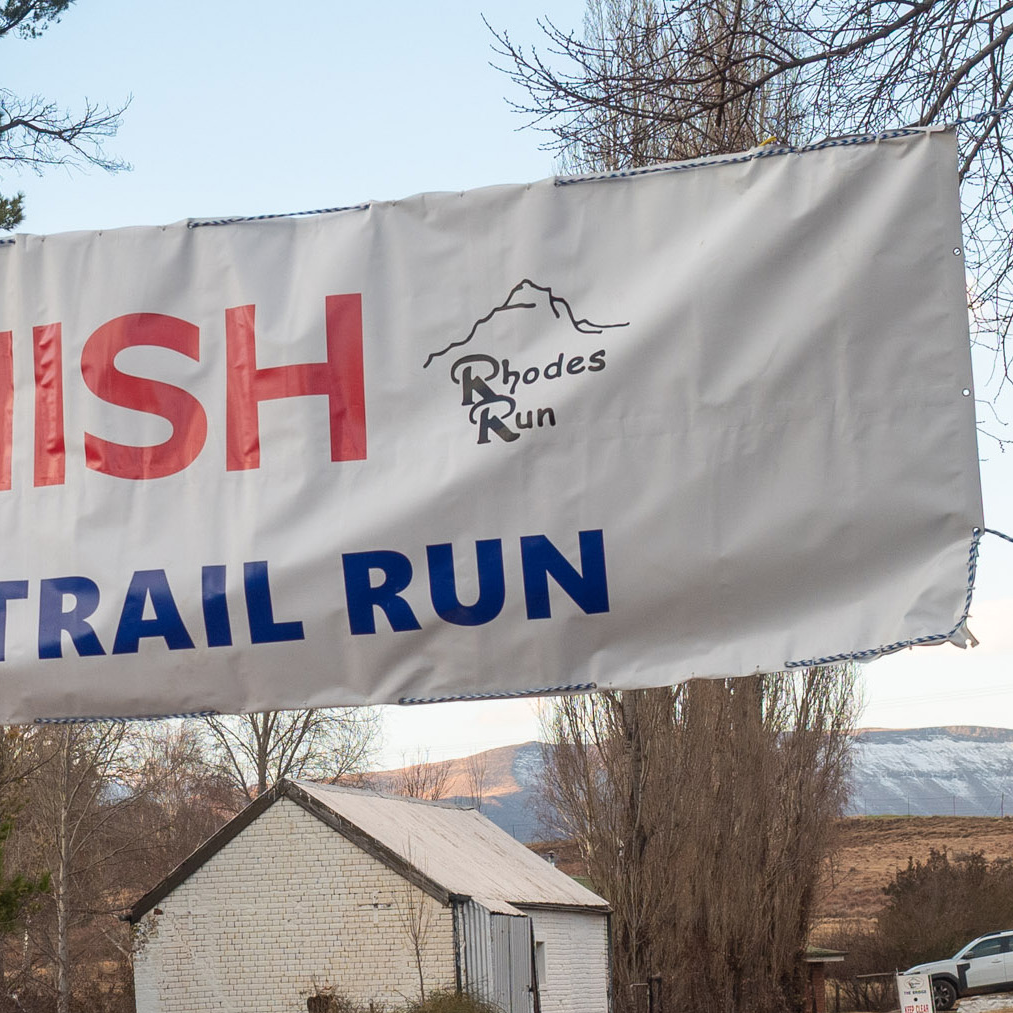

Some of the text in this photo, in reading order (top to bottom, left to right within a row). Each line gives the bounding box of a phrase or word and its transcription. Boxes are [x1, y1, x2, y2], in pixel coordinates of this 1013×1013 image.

[450, 346, 607, 406] Rhodes
[468, 393, 556, 444] Run
[341, 529, 610, 636] RUN
[905, 1004, 928, 1013] KEEP CLEAR
